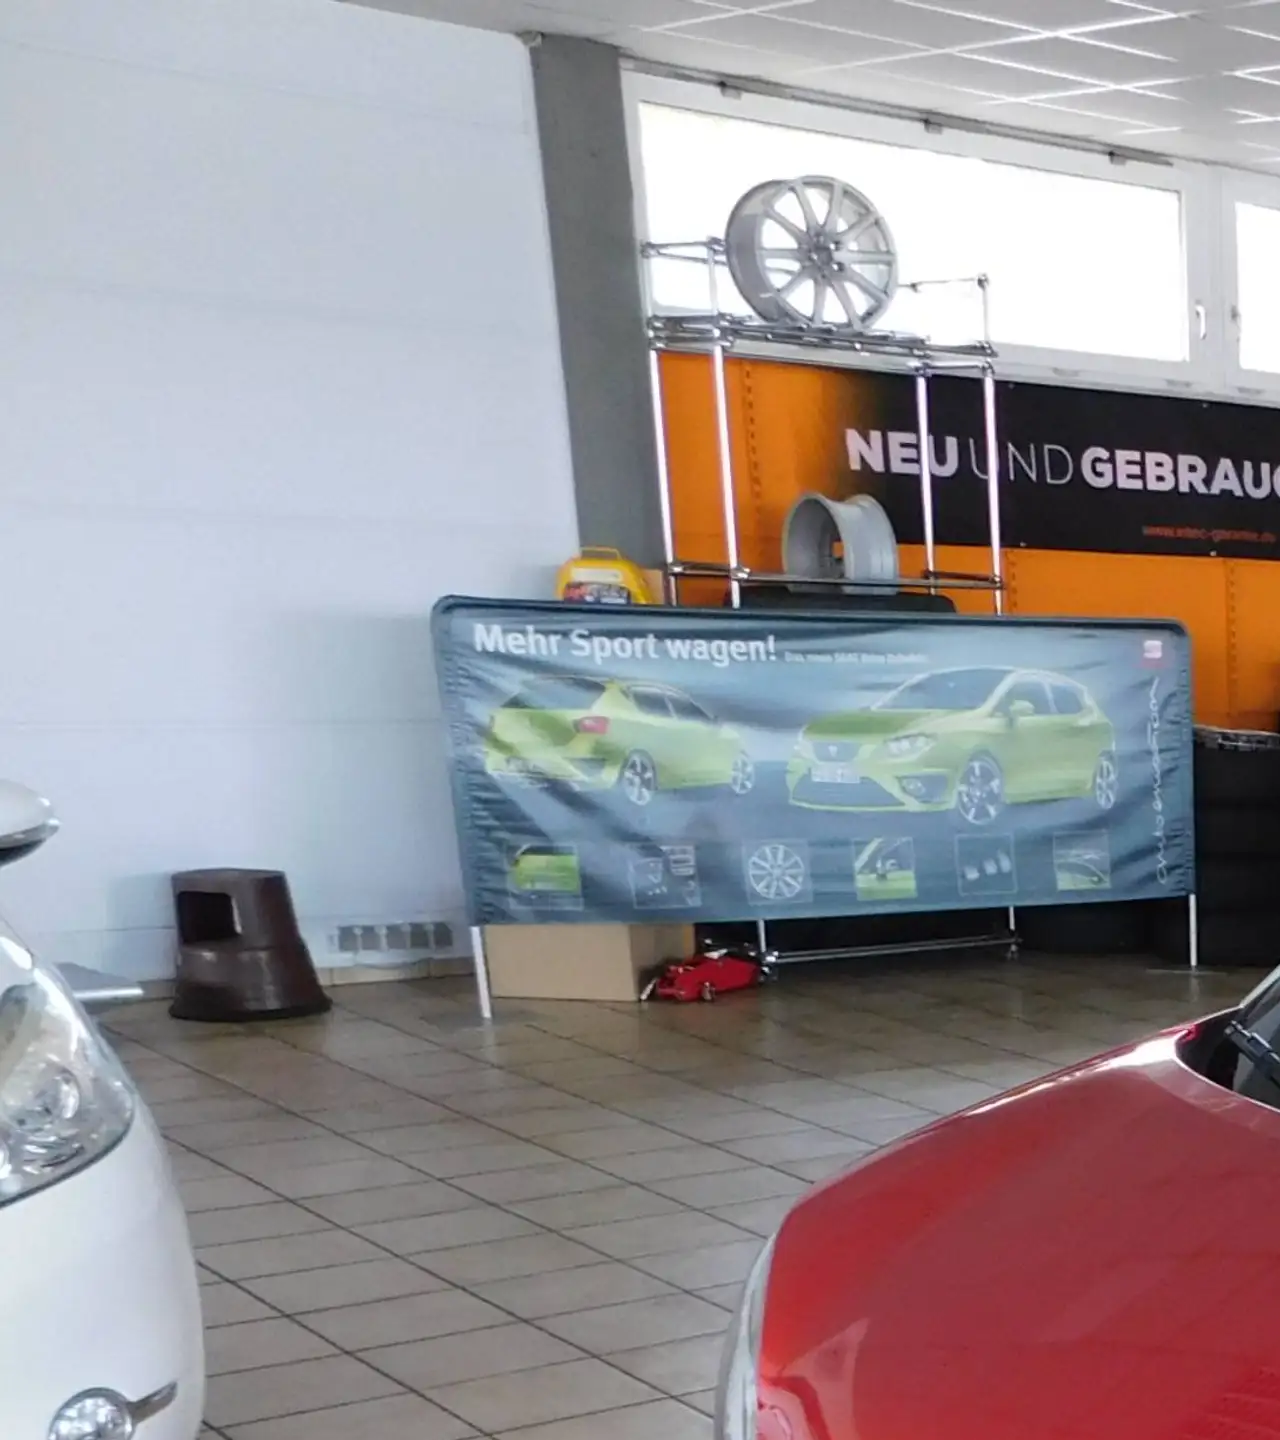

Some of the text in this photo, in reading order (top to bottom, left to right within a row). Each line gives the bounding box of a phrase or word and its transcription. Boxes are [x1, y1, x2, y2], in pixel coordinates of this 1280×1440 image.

[845, 428, 959, 478] NEU
[473, 623, 562, 656] Mehr
[570, 628, 660, 664] Sport
[665, 634, 777, 667] wagen!
